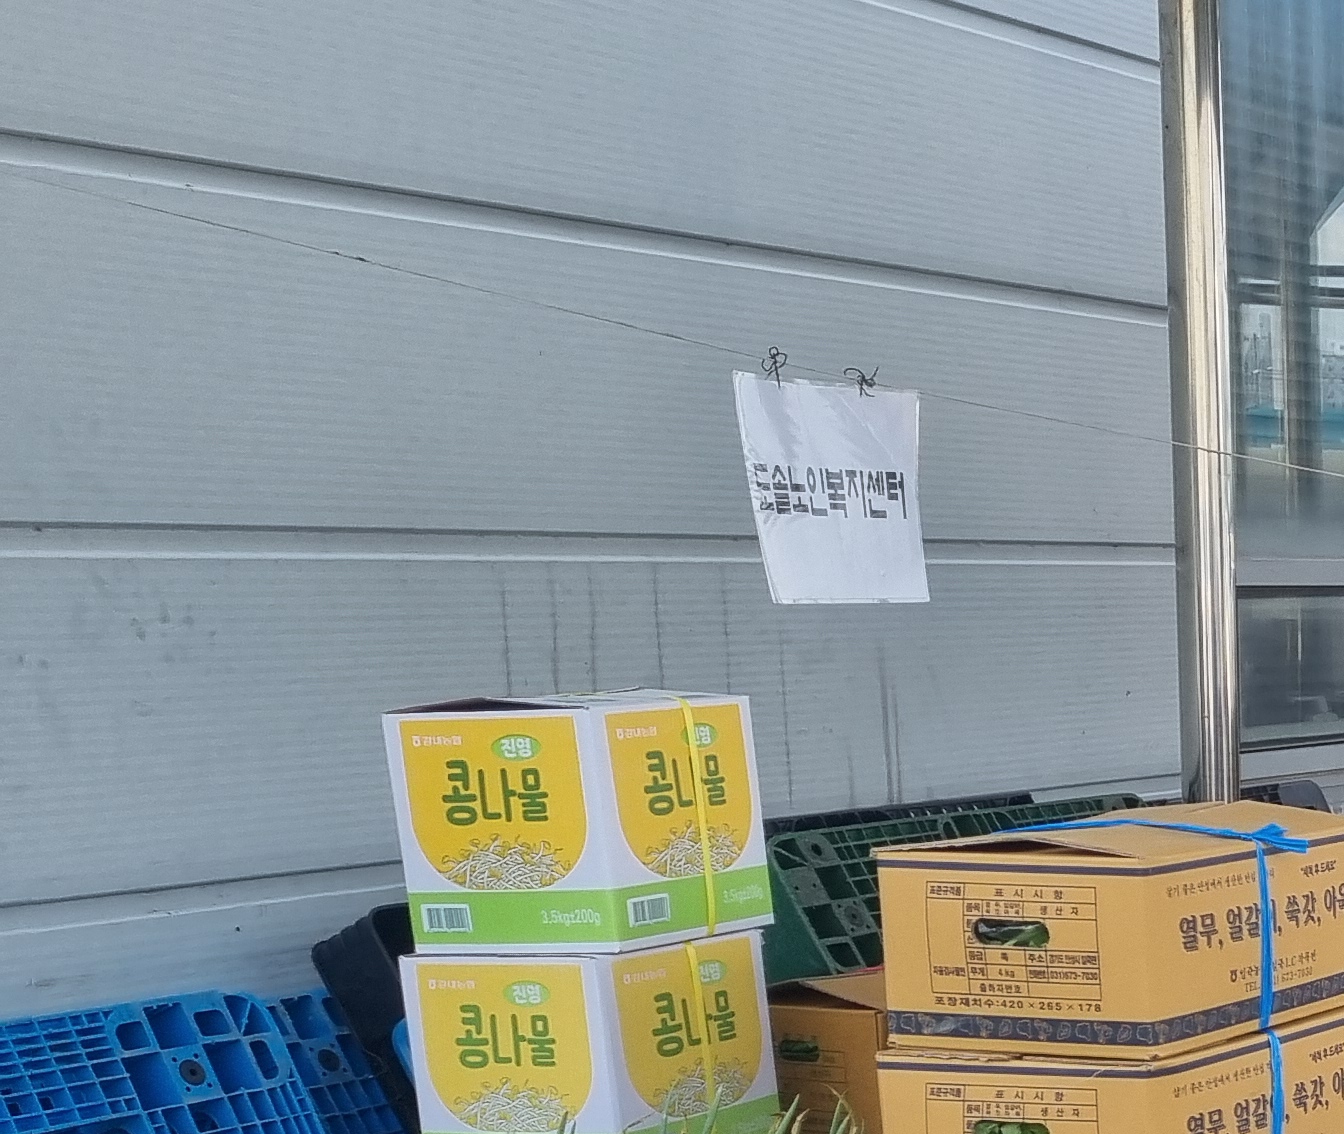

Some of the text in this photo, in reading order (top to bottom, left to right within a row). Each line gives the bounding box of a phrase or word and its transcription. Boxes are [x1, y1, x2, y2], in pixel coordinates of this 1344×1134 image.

[442, 759, 549, 826] 콩나물
[1179, 912, 1223, 953] 열무,
[455, 1004, 557, 1069] 콩나물
